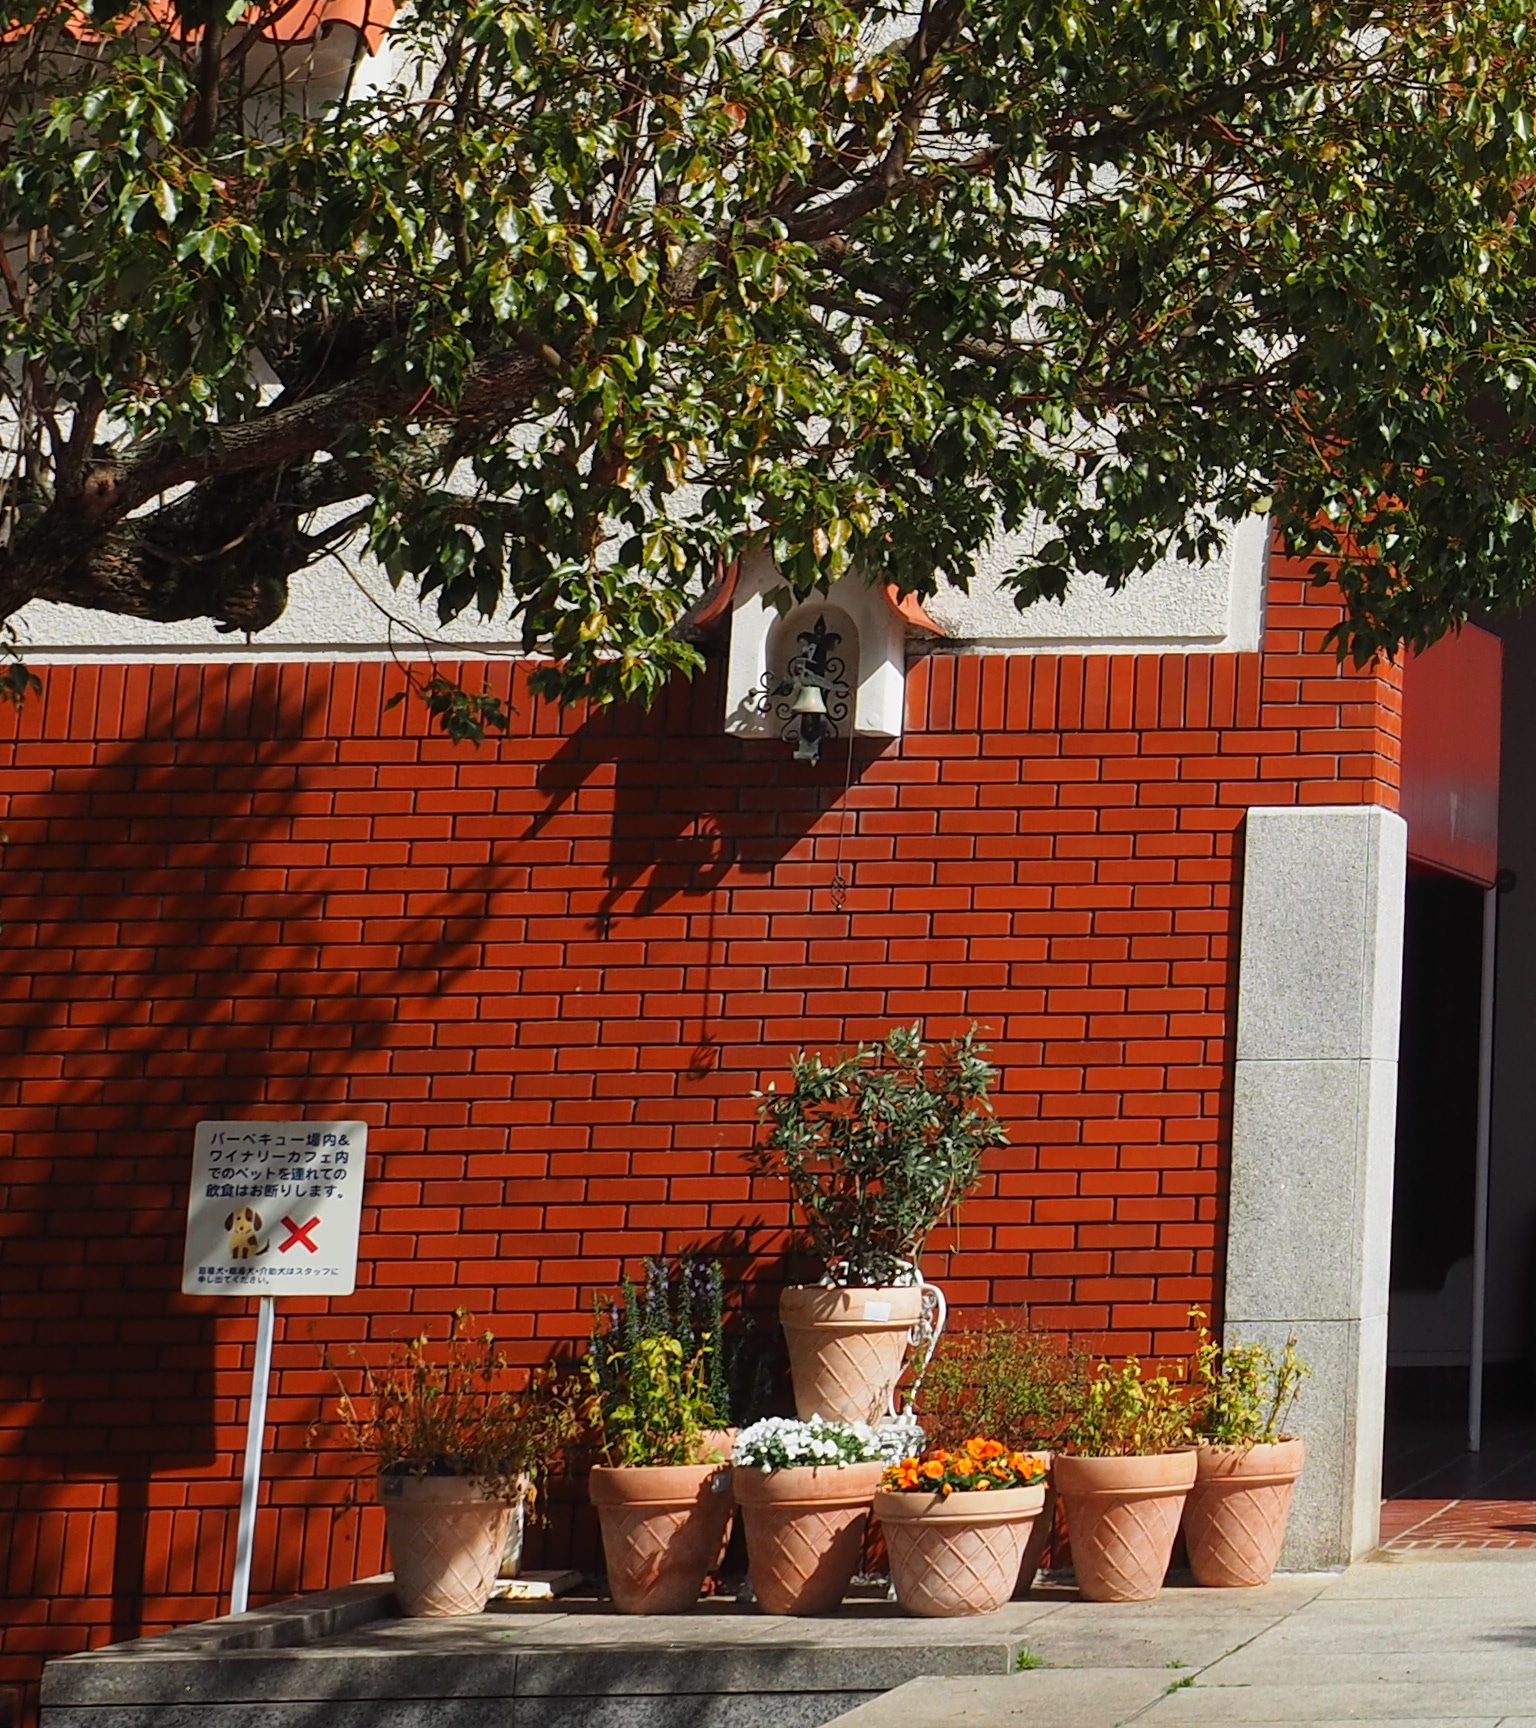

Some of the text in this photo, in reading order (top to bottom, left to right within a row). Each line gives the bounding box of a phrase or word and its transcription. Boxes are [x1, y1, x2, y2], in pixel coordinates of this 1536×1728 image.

[211, 1131, 351, 1147] バーベキュー場内&
[209, 1149, 349, 1164] ワイナリーカフェ内
[208, 1167, 348, 1181] でのペットを連れての
[205, 1184, 344, 1199] 飲食はお断りします。
